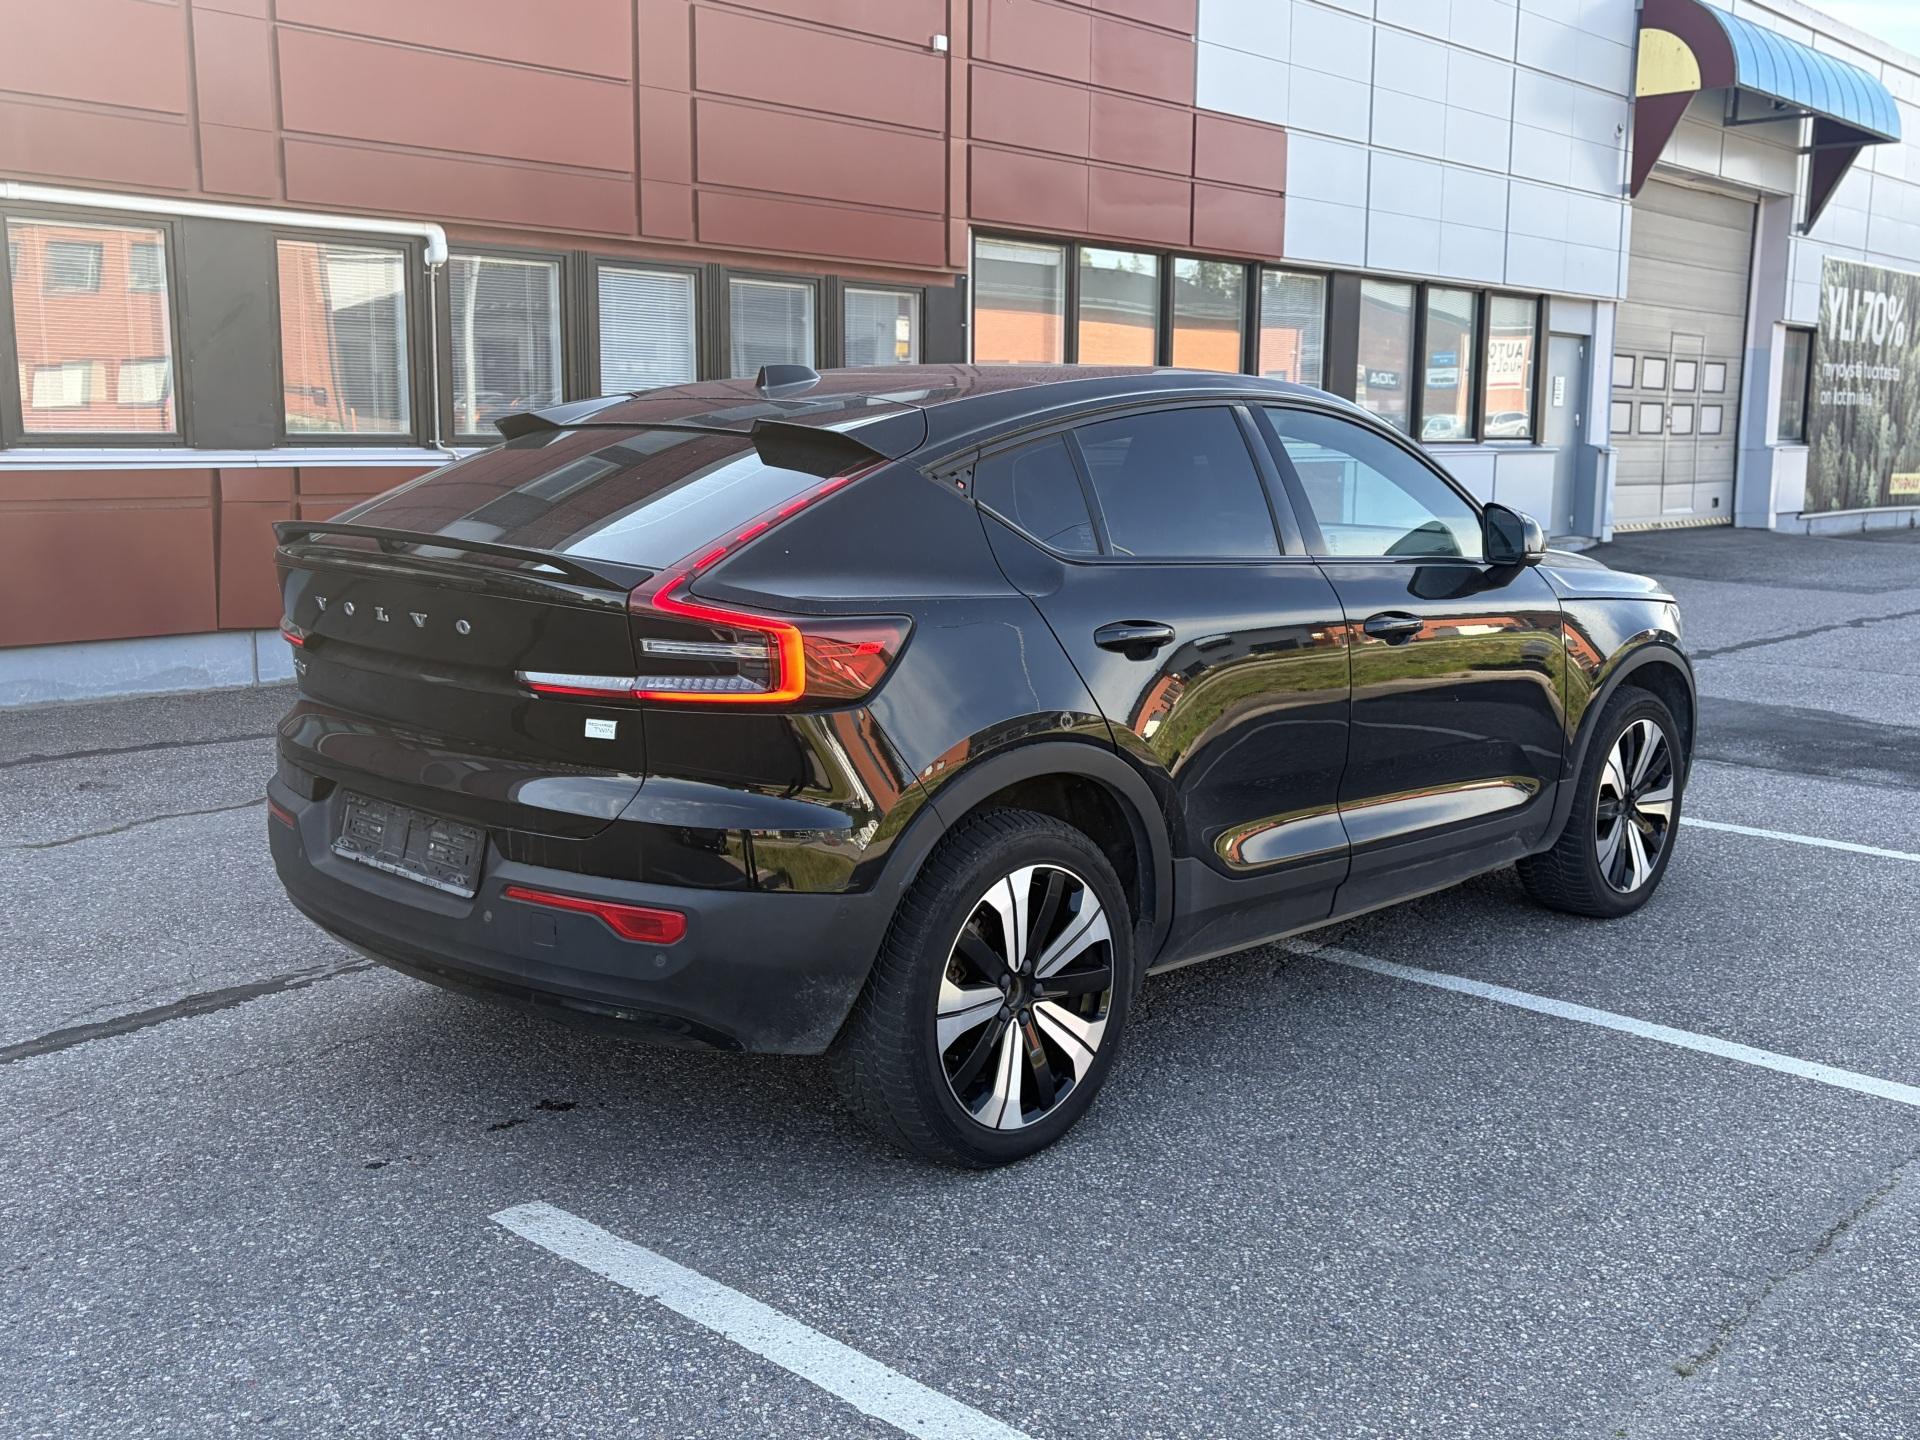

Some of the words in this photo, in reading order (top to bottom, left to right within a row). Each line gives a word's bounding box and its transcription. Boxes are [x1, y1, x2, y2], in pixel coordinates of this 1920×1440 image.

[1828, 285, 1860, 342] YLI
[1861, 290, 1905, 347] 70%
[315, 596, 471, 635] VOLVO
